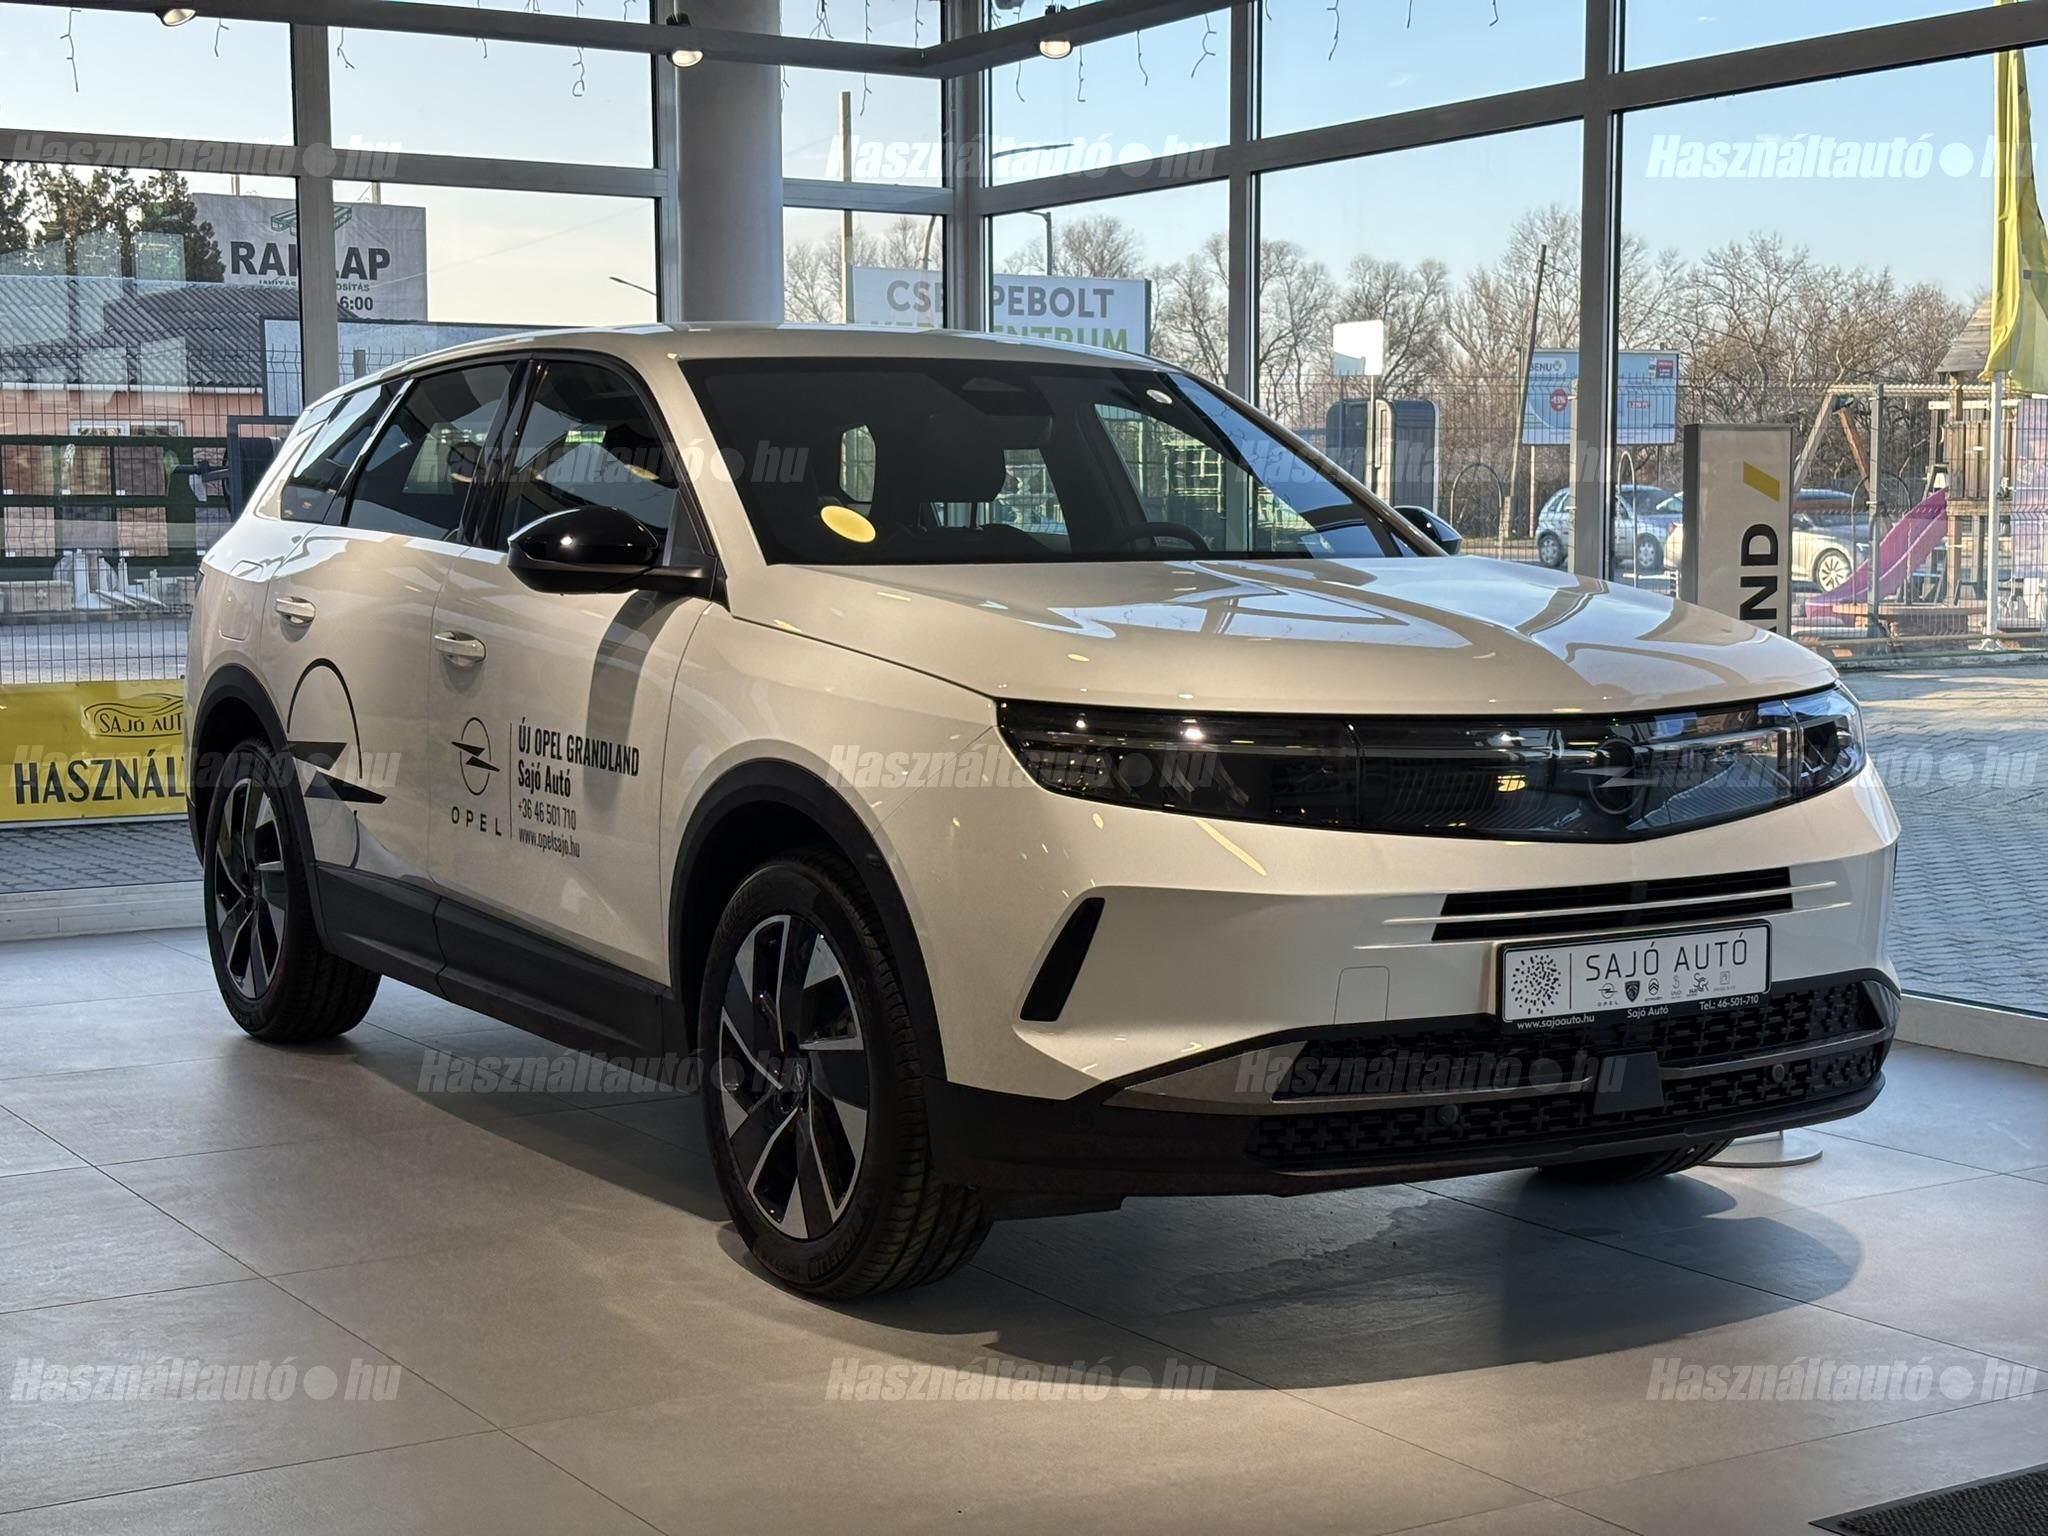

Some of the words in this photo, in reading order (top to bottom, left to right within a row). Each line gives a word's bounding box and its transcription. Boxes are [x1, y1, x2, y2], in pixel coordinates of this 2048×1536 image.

[230, 241, 390, 281] RAAP
[886, 280, 1115, 318] CSEPEBOLT
[1739, 523, 1779, 633] ND
[99, 713, 145, 734] SAJÓ
[152, 712, 183, 733] AUT
[517, 716, 531, 754] ÚJ
[534, 728, 563, 761] OPEL
[567, 734, 640, 776] GRANDLAND
[14, 749, 186, 805] HASZNÁL
[517, 759, 541, 795] Sajó
[544, 765, 571, 798] Autó
[451, 805, 502, 837] OPEL
[517, 797, 532, 820] +36
[534, 801, 545, 824] 46
[546, 804, 561, 828] 501
[562, 807, 577, 830] 710
[1585, 941, 1660, 982] SAJÓ
[1673, 931, 1748, 973] AUTÓ
[1516, 1013, 1595, 1031] www.sajoauto.hu
[1627, 1007, 1646, 1020] Sajó
[1647, 1005, 1669, 1017] Autó
[1717, 994, 1760, 1008] 46-501-710
